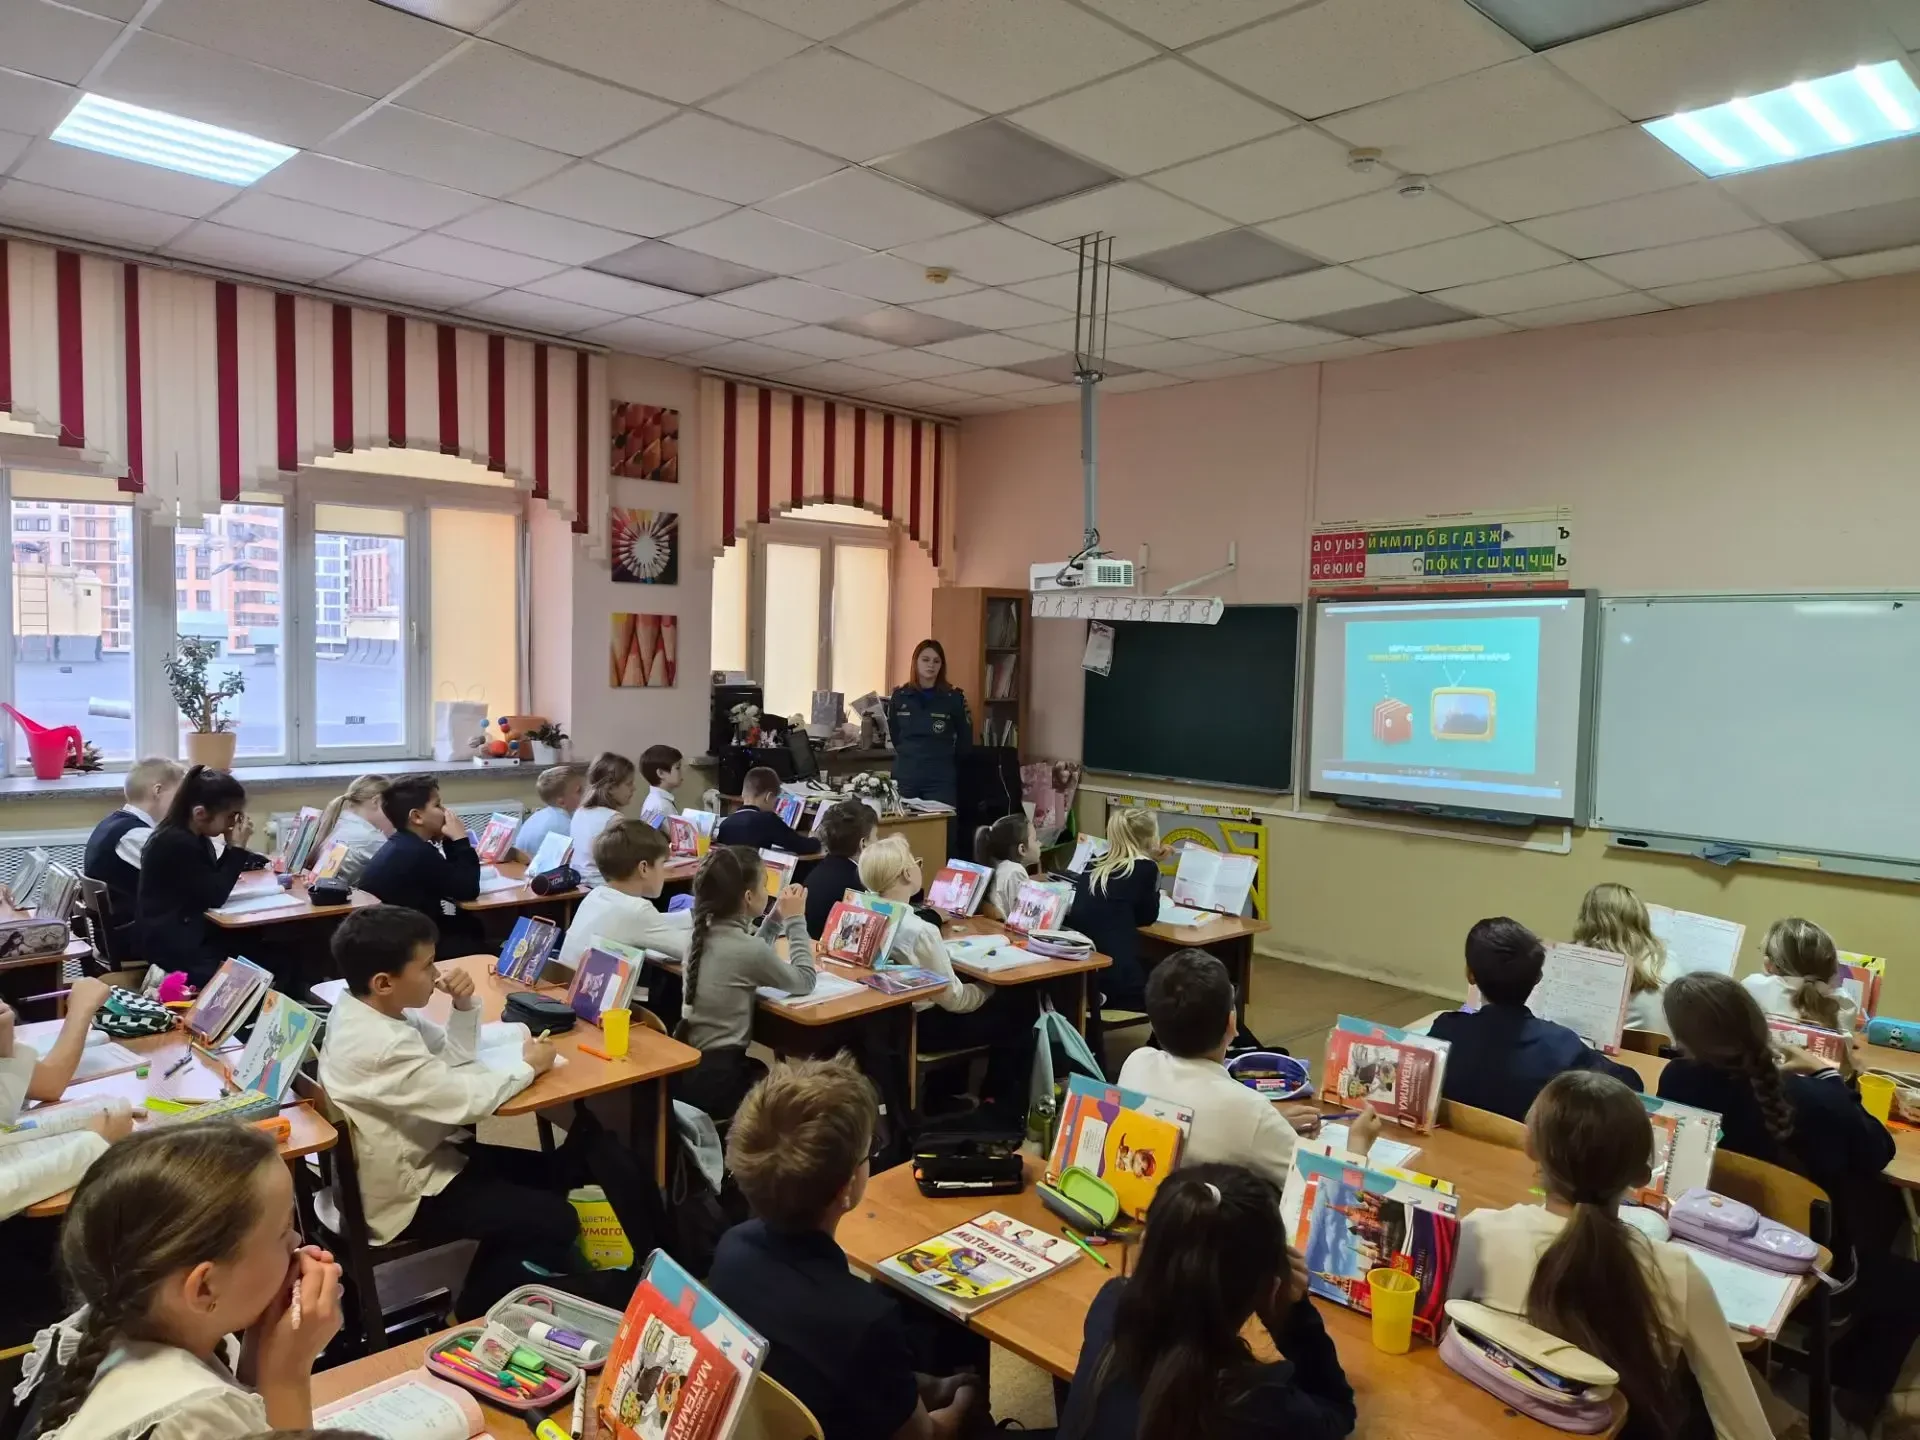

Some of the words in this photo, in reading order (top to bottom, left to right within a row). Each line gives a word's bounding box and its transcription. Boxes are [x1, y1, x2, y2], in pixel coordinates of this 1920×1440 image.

[1398, 1051, 1416, 1110] МАТЕМАТИКА
[583, 1227, 623, 1238] умага
[669, 1359, 713, 1440] МАТЕМАТ
